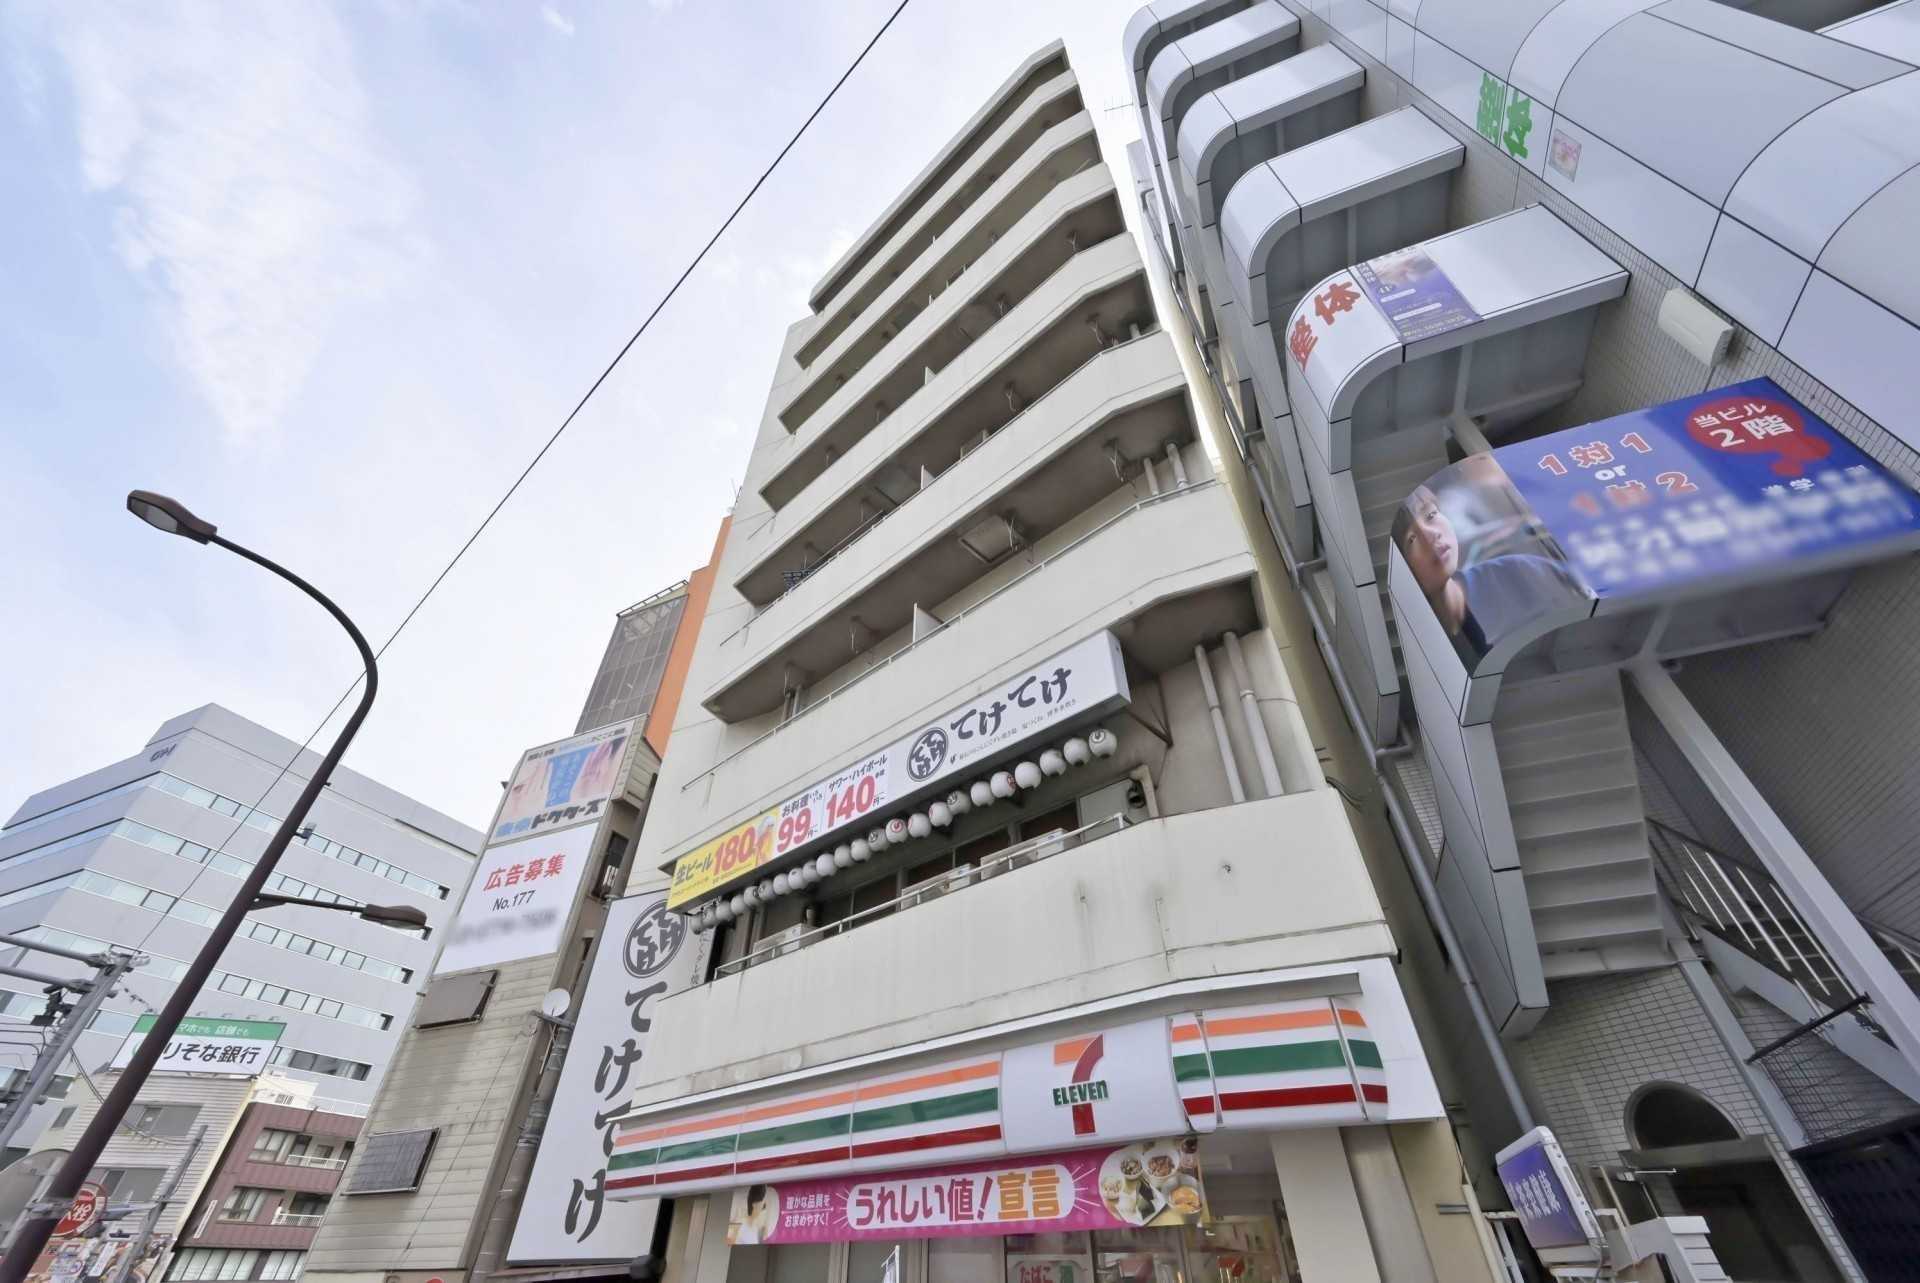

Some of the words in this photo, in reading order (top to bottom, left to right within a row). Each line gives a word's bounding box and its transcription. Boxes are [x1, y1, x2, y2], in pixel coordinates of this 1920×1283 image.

[1693, 403, 1767, 428] 当ビル
[1709, 415, 1794, 448] 2階
[1594, 465, 1627, 481] or
[950, 667, 1072, 740] てけてけ
[826, 776, 876, 828] 140
[777, 808, 812, 853] 99
[483, 852, 566, 892] 広告募集
[674, 853, 713, 886] 生ビール
[713, 826, 757, 876] 180
[492, 889, 537, 912] No.177
[163, 1042, 262, 1065] りそな銀行
[564, 980, 668, 1244] てけてけ
